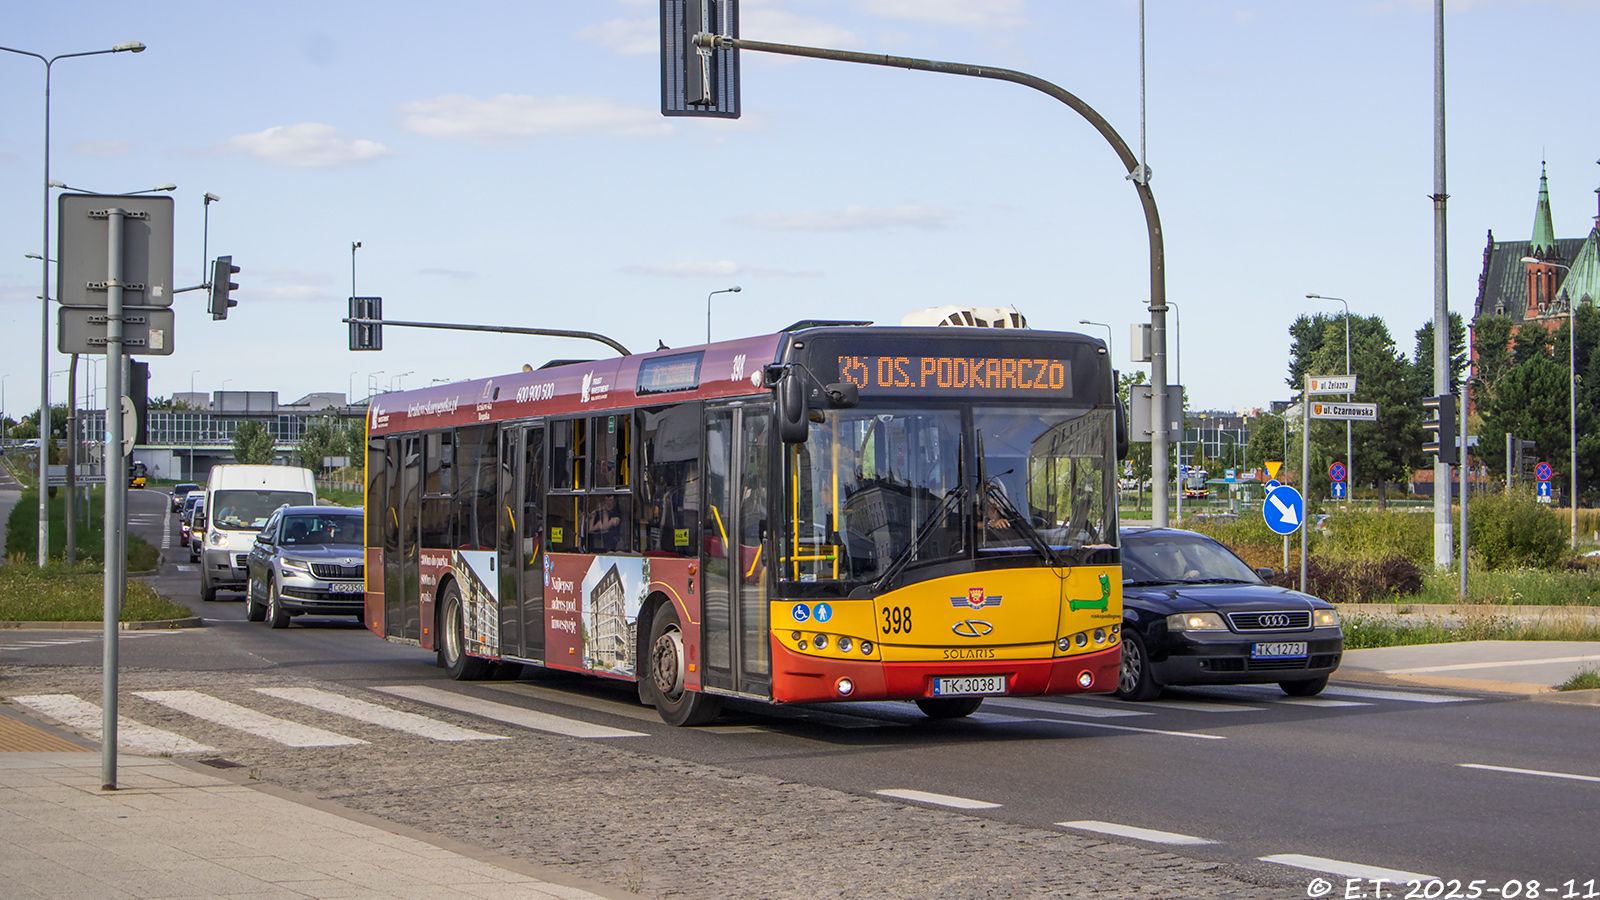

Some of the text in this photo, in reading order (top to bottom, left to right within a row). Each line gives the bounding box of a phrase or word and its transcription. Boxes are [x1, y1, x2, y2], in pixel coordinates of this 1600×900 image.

[731, 354, 746, 382] 398
[878, 356, 915, 388] OS.
[515, 383, 554, 403] 600 900 500
[1323, 406, 1374, 417] ul. Czarnowska
[882, 606, 912, 634] 398
[943, 649, 995, 659] SOLARIS
[1258, 643, 1305, 655] TK 1273J
[942, 678, 1002, 693] TK 3038J
